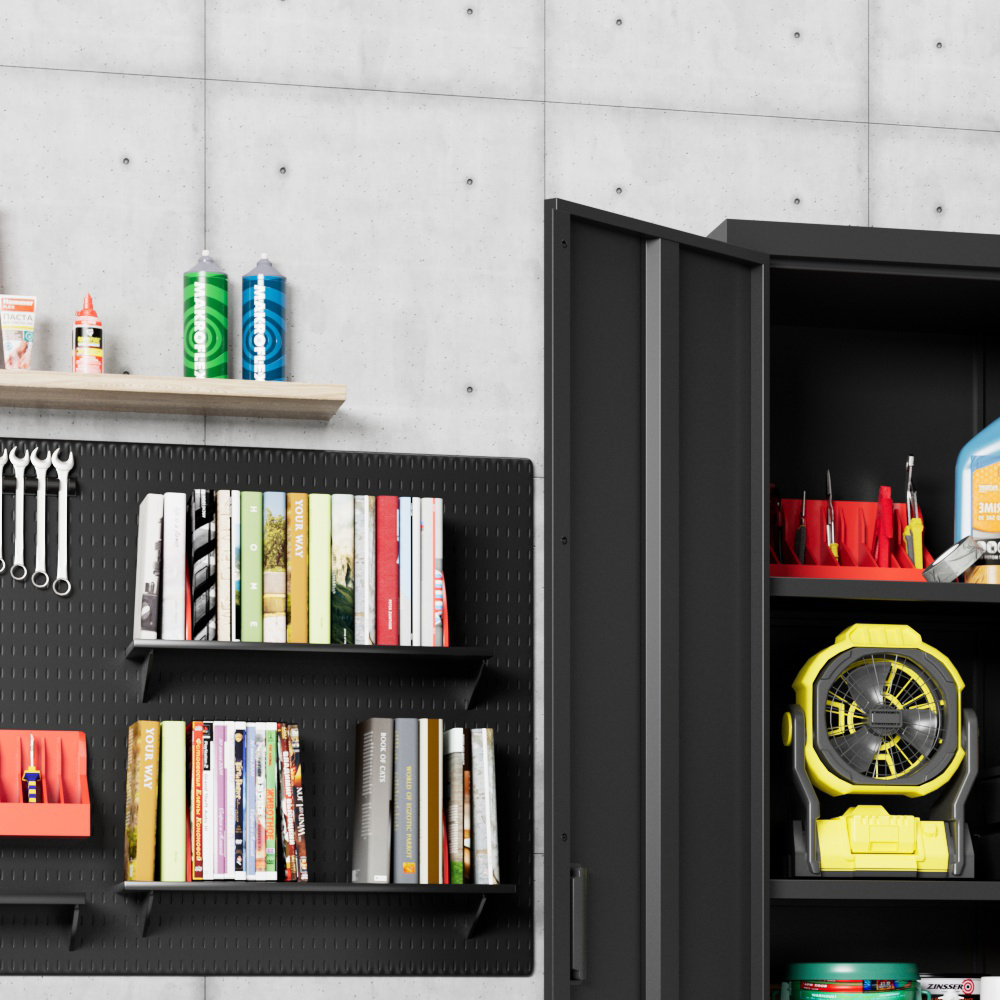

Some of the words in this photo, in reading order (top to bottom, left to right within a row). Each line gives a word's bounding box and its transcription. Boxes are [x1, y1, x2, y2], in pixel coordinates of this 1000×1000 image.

[3, 313, 33, 321] ПАСТА
[294, 499, 304, 531] YOUR
[294, 533, 304, 558] WAY
[144, 727, 155, 761] YOUR
[379, 754, 386, 763] OF
[143, 763, 154, 790] WAY
[283, 751, 292, 797] ВЛАДИМИР
[405, 792, 412, 801] OF
[266, 788, 274, 840] ЖИВОТНОЕ
